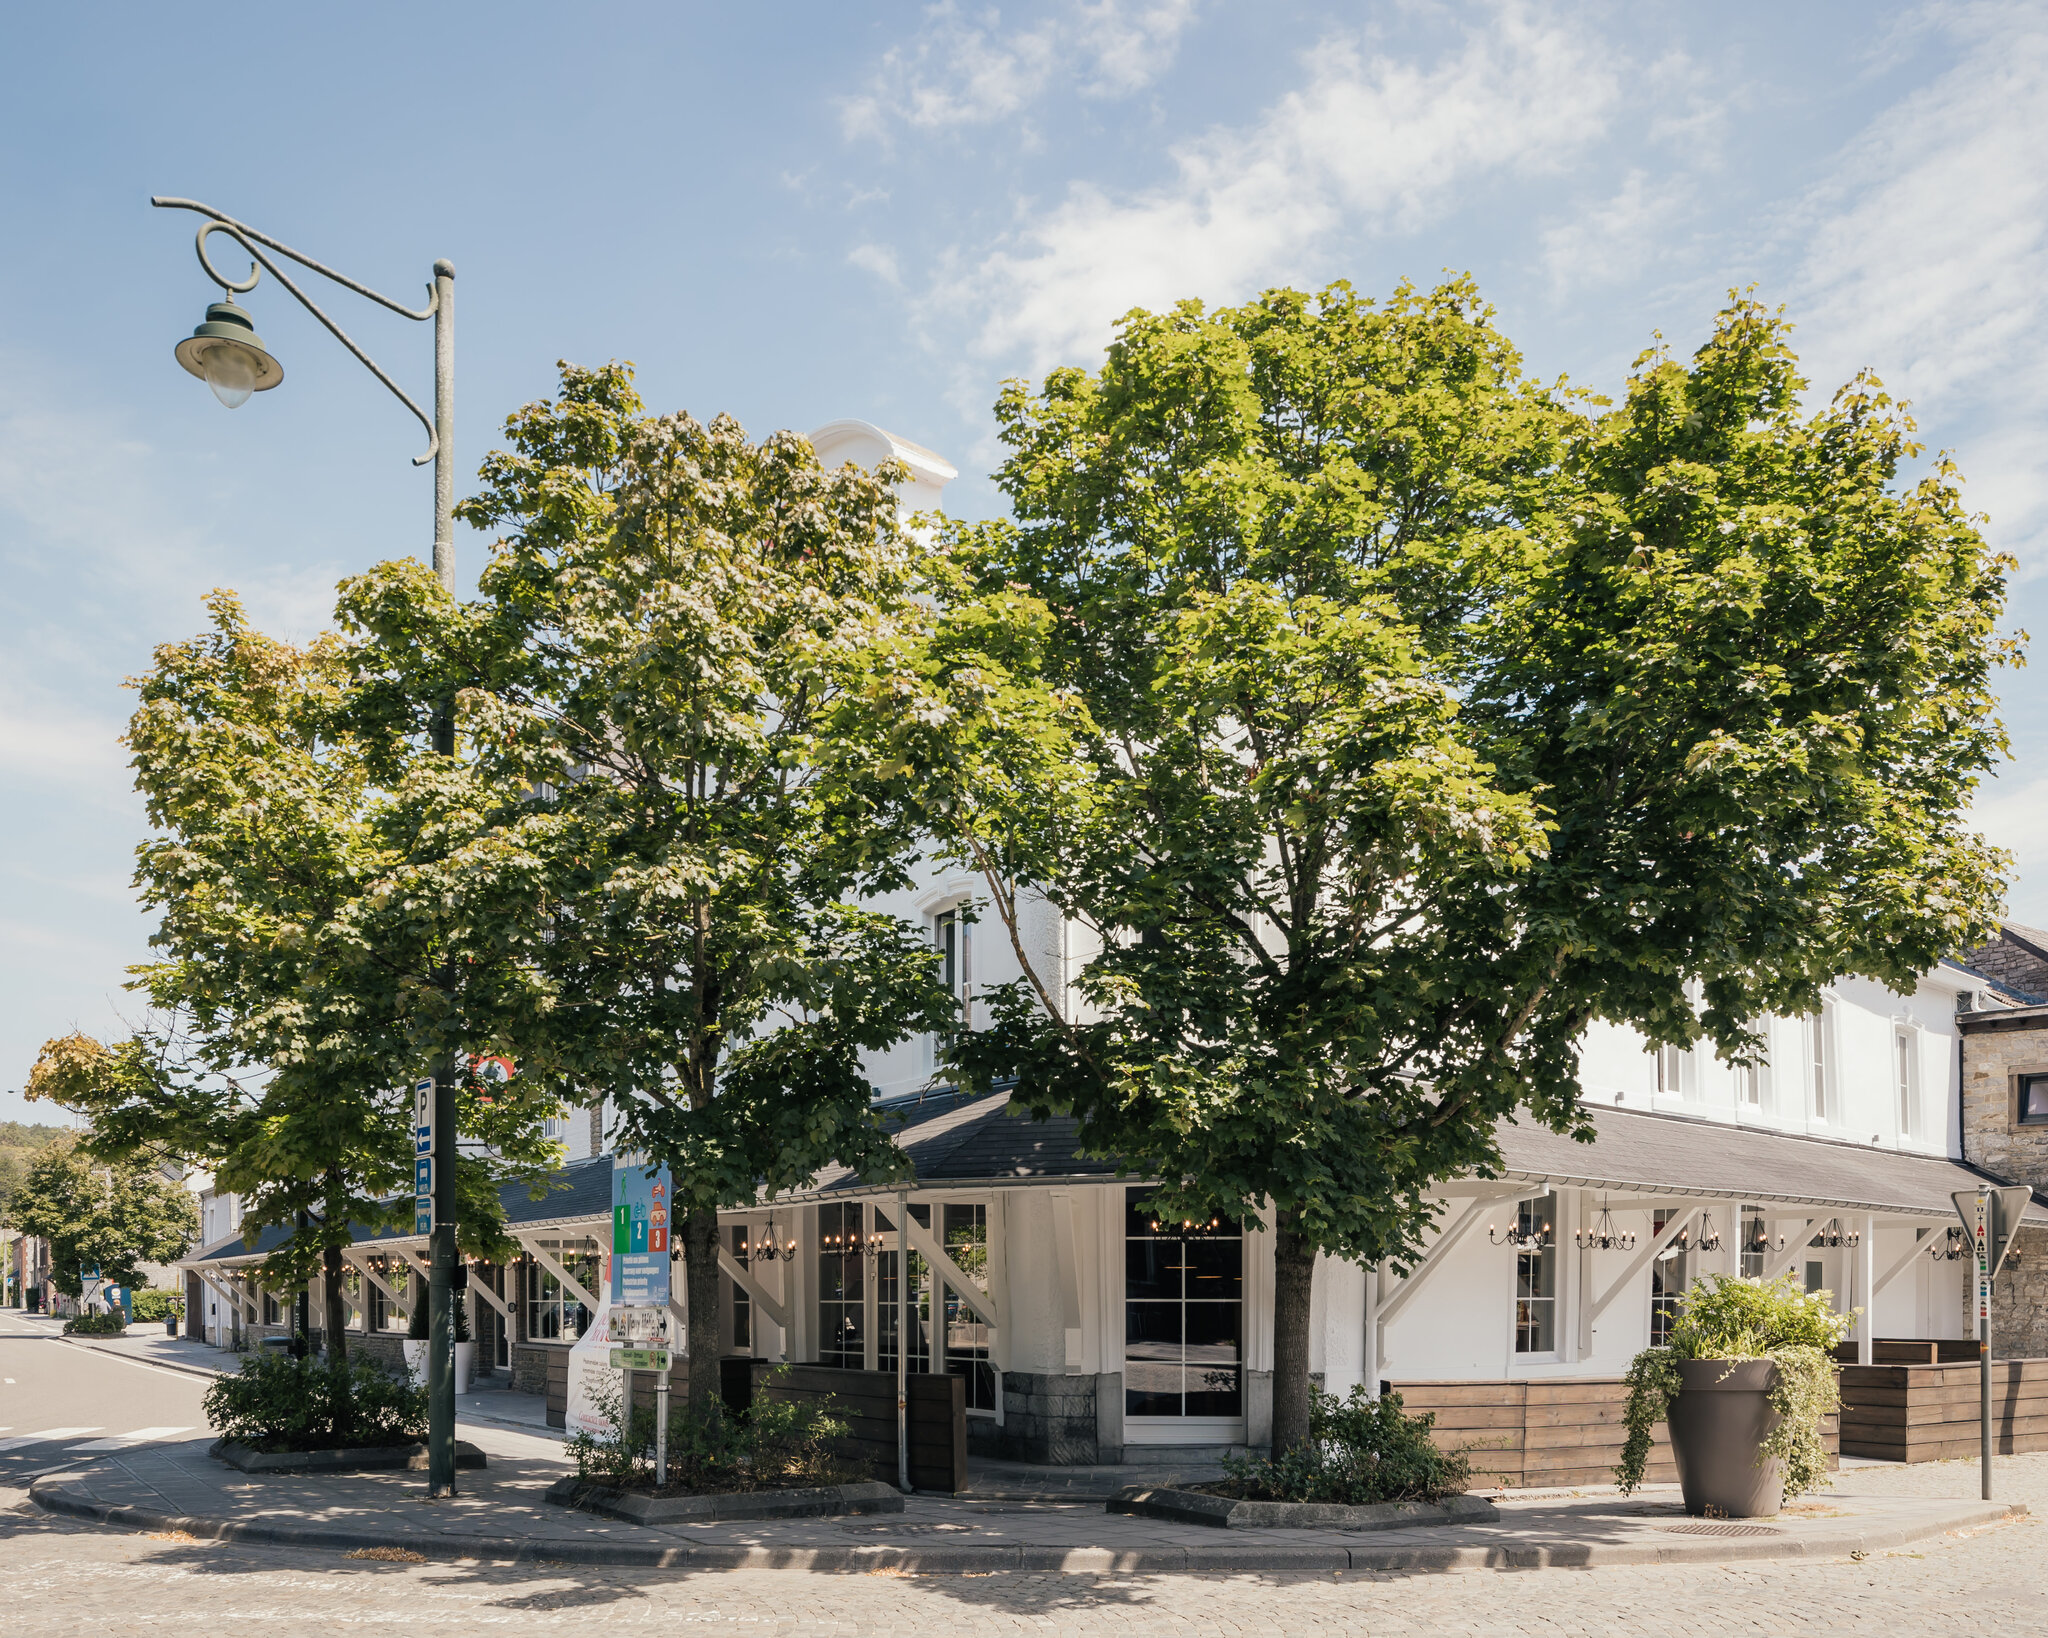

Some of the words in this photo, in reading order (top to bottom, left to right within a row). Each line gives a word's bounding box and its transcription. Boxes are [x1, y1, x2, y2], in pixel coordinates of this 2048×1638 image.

[420, 1091, 427, 1125] P
[620, 1208, 625, 1225] 1
[637, 1222, 642, 1239] 2
[655, 1230, 660, 1248] 3
